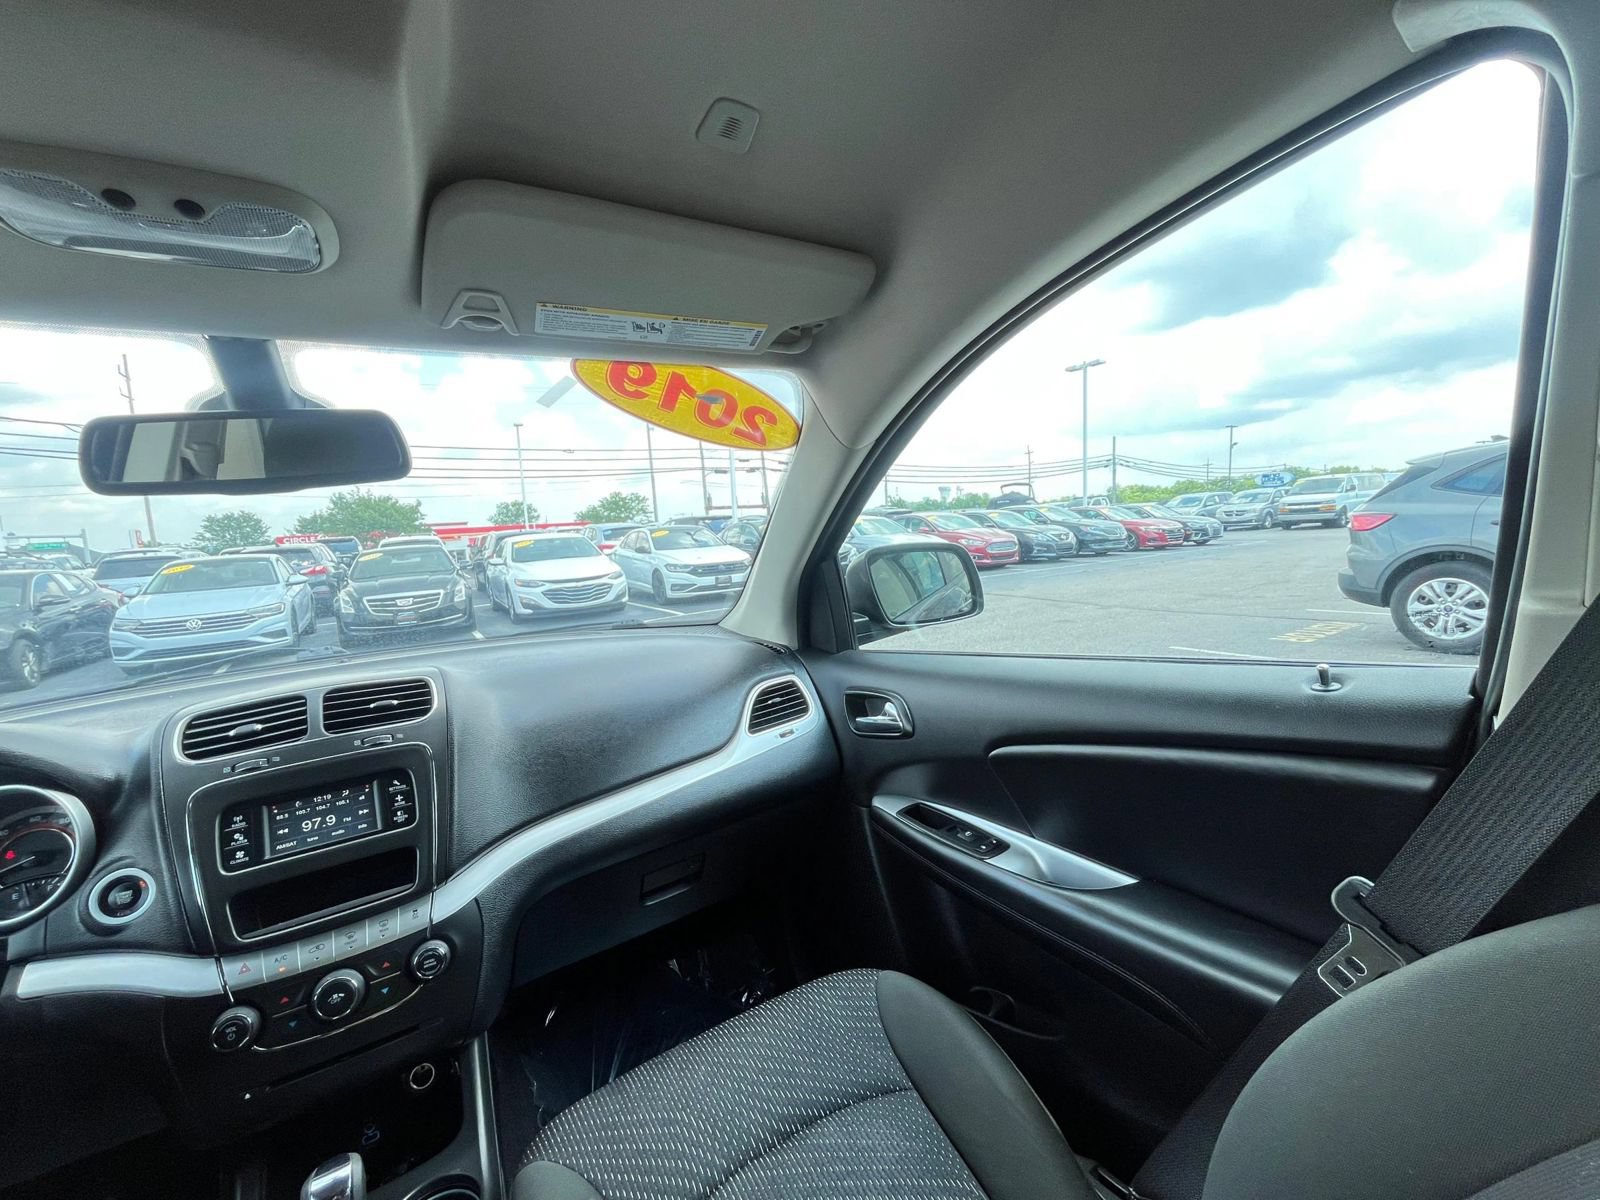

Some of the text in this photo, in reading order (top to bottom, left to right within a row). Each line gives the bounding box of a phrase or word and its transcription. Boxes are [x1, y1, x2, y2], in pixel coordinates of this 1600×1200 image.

[283, 535, 316, 545] CIRCLE
[313, 794, 332, 803] 12:19
[302, 814, 336, 832] 97.9
[273, 953, 288, 964] A/C
